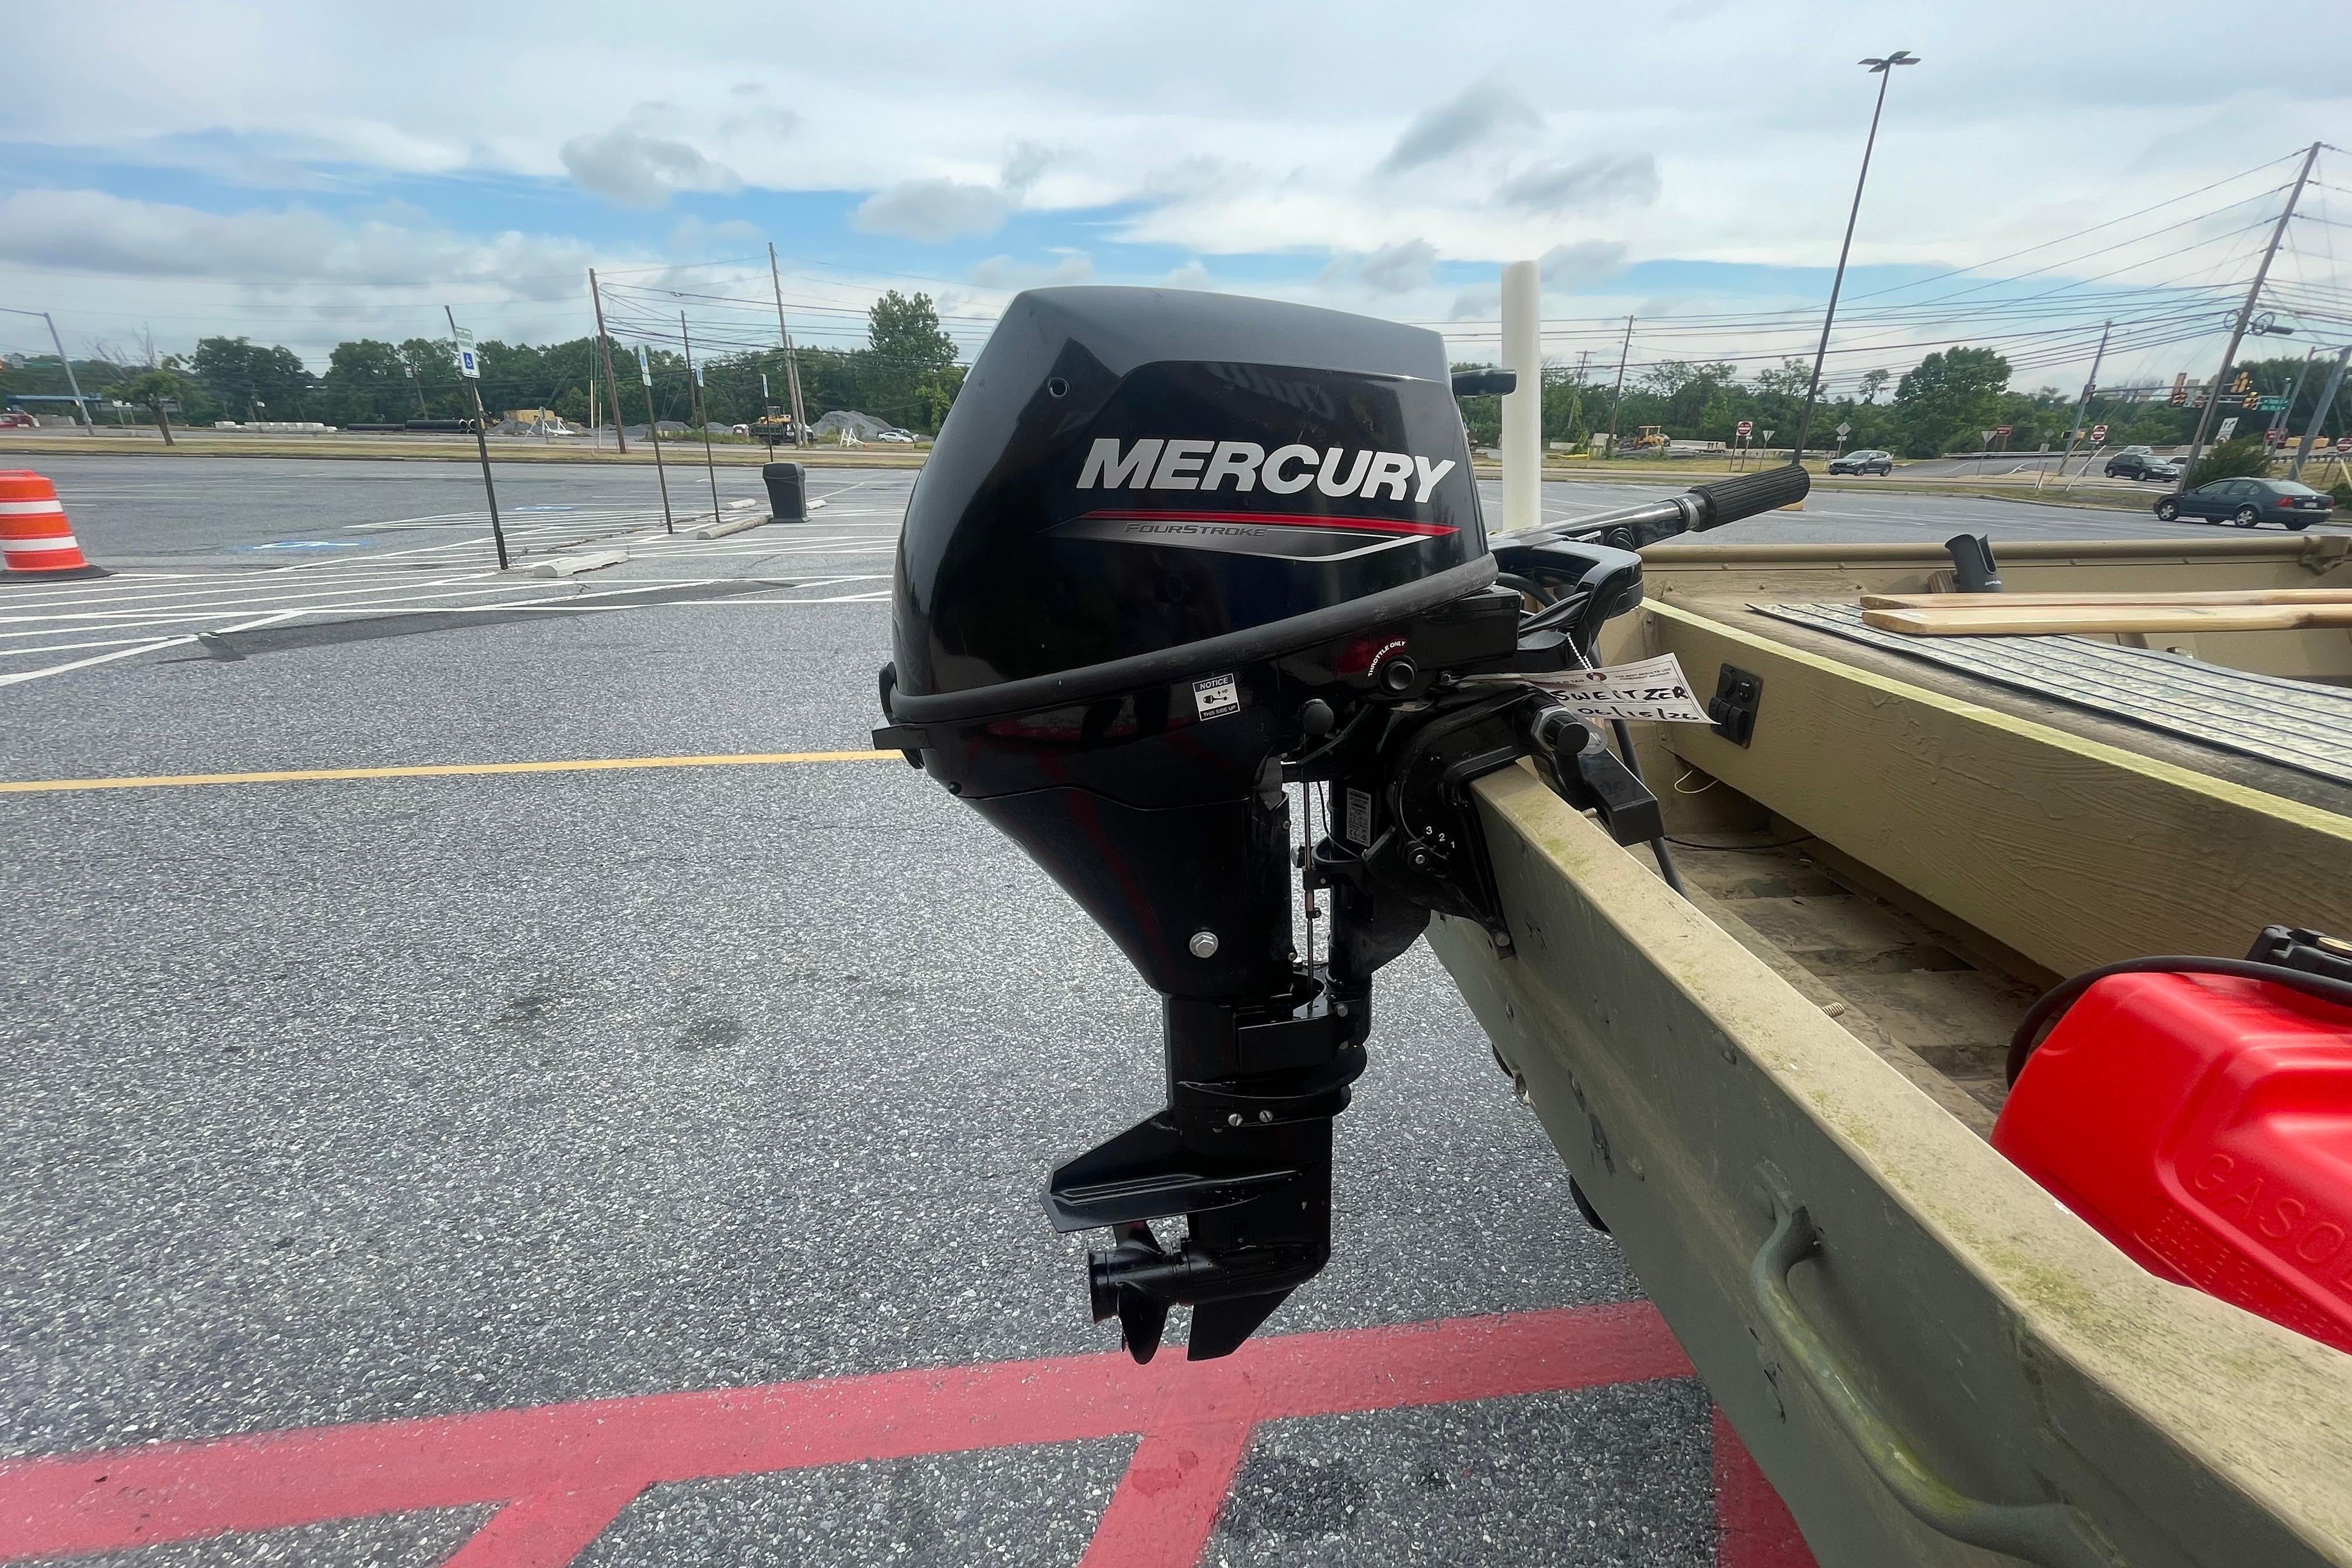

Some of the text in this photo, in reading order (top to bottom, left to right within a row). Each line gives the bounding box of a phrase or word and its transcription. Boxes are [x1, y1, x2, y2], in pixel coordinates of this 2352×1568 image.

[1076, 438, 1455, 503] MERCURY
[1367, 645, 1390, 677] THROTTLE
[1200, 677, 1228, 690] NOTICE
[1549, 686, 1689, 701] SWEITZER
[1426, 826, 1433, 835] 3
[1438, 833, 1446, 842] 2
